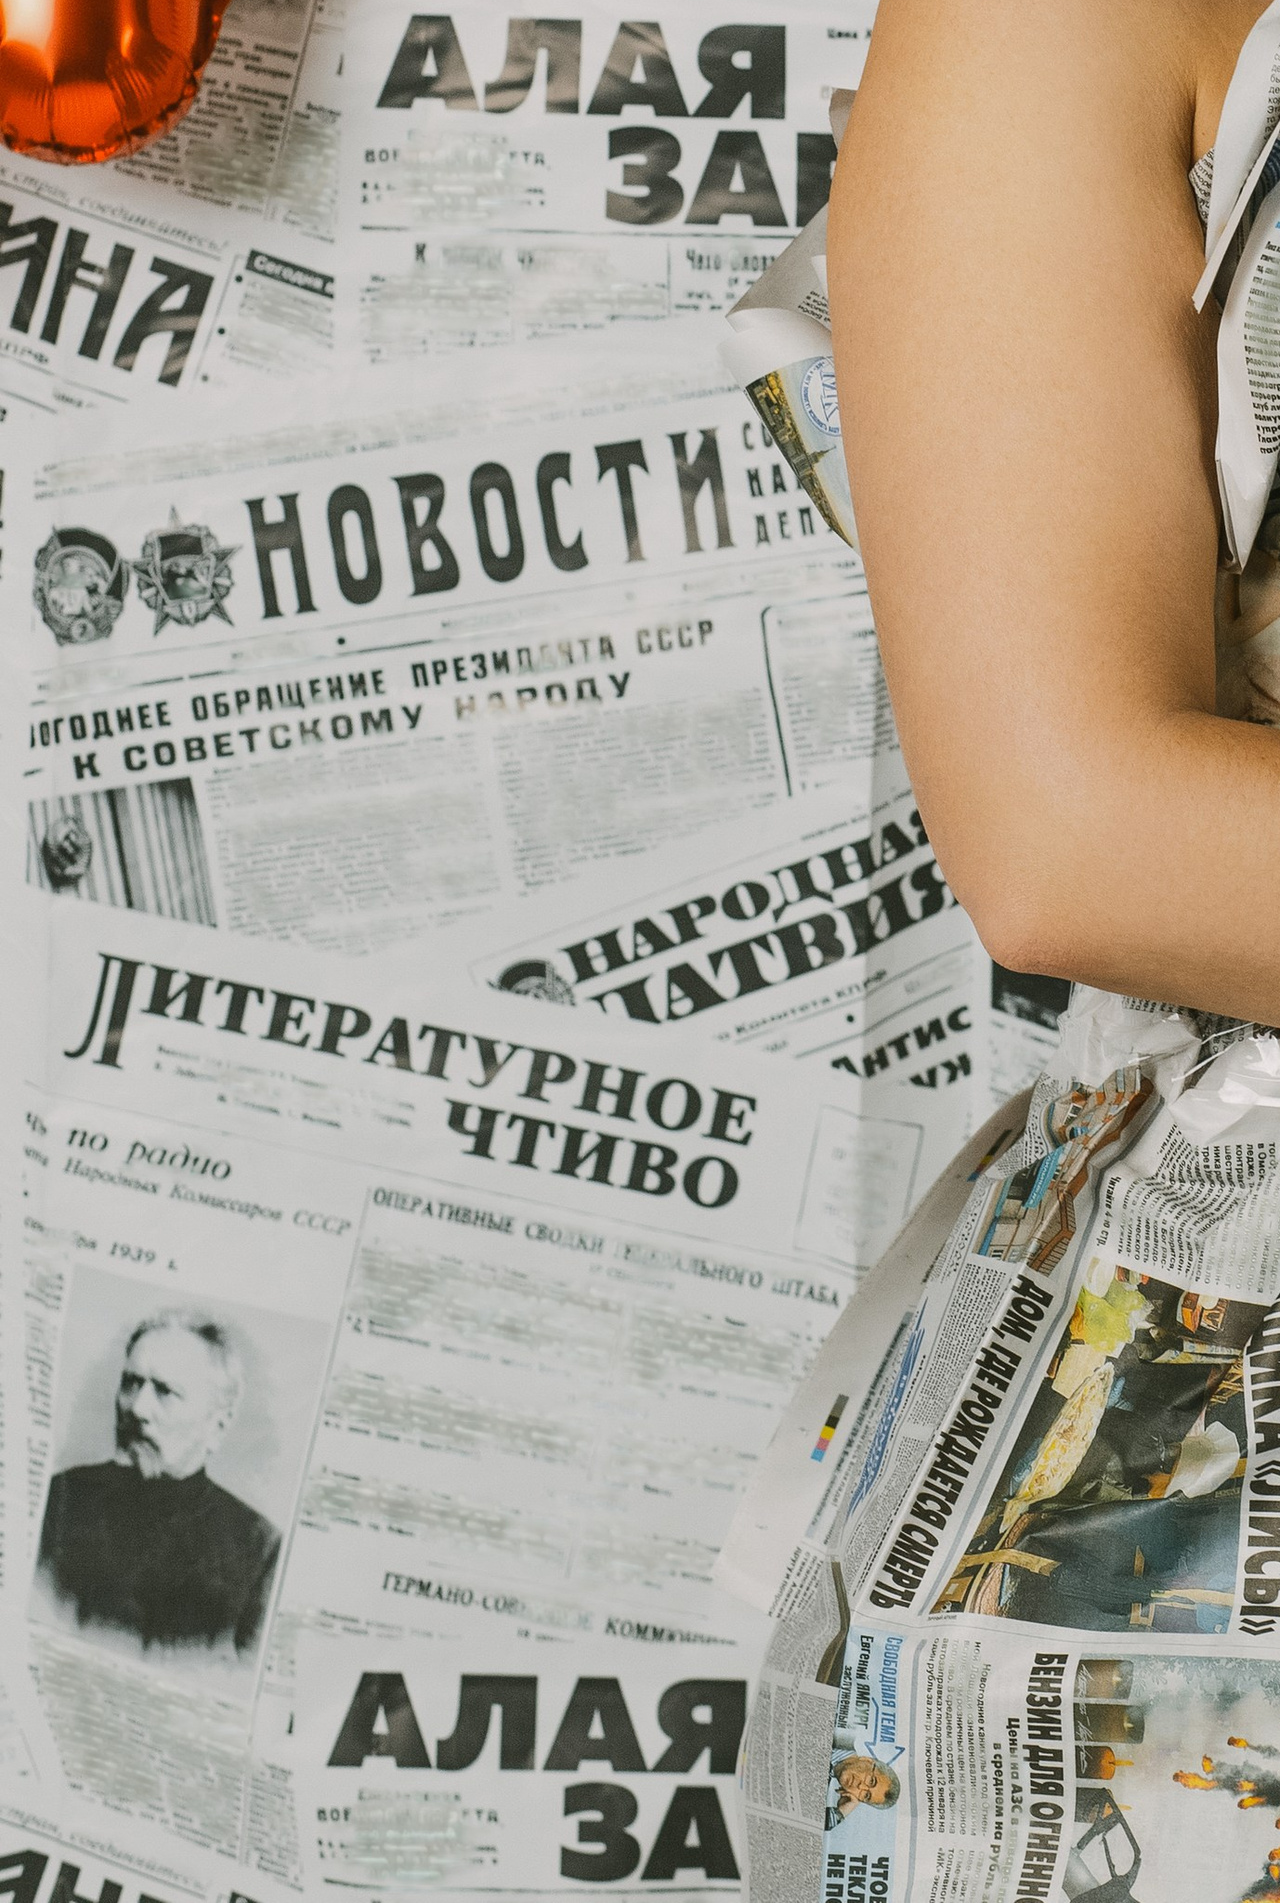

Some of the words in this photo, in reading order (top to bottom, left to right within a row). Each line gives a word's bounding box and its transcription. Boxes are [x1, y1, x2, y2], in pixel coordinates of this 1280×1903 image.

[375, 14, 787, 120] АЛАЯ
[244, 426, 738, 620] НОВОСТИ
[190, 669, 386, 722] ОБРАЩЕНИЕ
[411, 634, 616, 689] ПРЕЗИДЕНТА
[635, 619, 714, 655] СССР
[73, 753, 102, 780] К
[122, 703, 425, 773] СОВЕТСКОМУ
[454, 670, 632, 722] НАРОДУ
[64, 950, 758, 1147] ЛИТЕРАТУРНОЕ
[67, 1125, 109, 1153] по
[126, 1140, 233, 1183] радио
[444, 1098, 740, 1210] ЧТИВО
[62, 1155, 161, 1199] Народных
[169, 1180, 285, 1221] Комиссаров
[292, 1205, 352, 1236] СССР
[110, 1241, 156, 1266] 1939
[372, 1185, 517, 1236] ОПЕРАТИВНЫЕ
[524, 1219, 605, 1257] СВОДКИ
[769, 1276, 839, 1309] ШТАБА
[999, 1274, 1054, 1348] ДОМ,
[975, 1344, 1025, 1392] ГДЕ
[905, 1378, 1006, 1528] РОЖДАЕТСЯ
[873, 1518, 933, 1611] СМЕРТЬ
[854, 1634, 875, 1680] Евгений
[877, 1636, 906, 1708] СВОБОДНАЯ
[325, 1671, 749, 1775] АЛАЯ
[852, 1683, 873, 1730] ЯМБУРГ
[879, 1711, 897, 1743] ТЕМА
[1025, 1652, 1069, 1742] БЕНЗИН
[922, 1736, 935, 1783] Ключевой
[933, 1714, 944, 1768] подорожал
[1006, 1717, 1020, 1757] Цены
[1026, 1745, 1066, 1793] ДЛЯ
[925, 1786, 936, 1832] причиной
[935, 1787, 947, 1822] января
[990, 1754, 1004, 1816] среднем
[1009, 1784, 1023, 1813] АЗС
